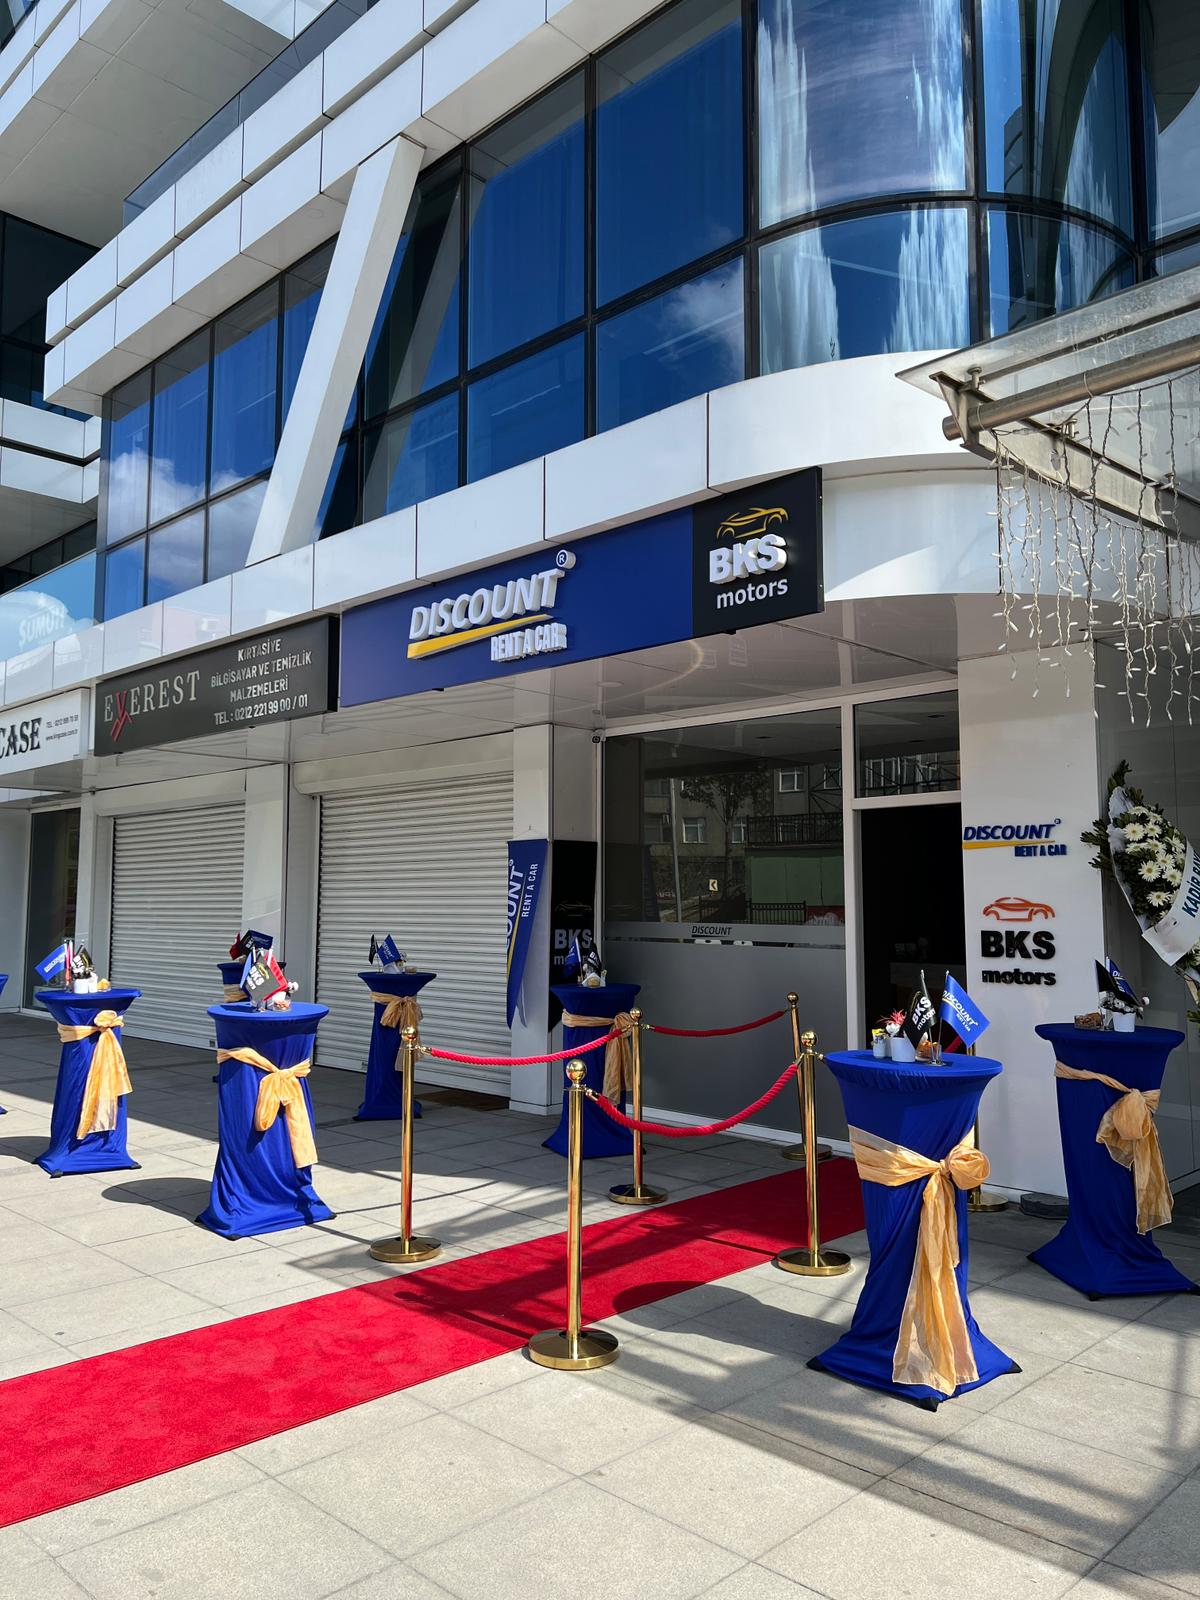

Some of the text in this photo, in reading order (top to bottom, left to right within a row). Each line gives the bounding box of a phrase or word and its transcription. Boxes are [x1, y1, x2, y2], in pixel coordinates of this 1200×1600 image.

[709, 534, 788, 584] BKS
[409, 568, 566, 640] DISCOUNT
[716, 578, 788, 609] motors
[238, 639, 282, 662] KIRTASİYE
[490, 622, 568, 662] RENT A CAR
[211, 650, 312, 688] BİLGİSAYAR VE TEMİZLİK
[103, 670, 200, 724] EVEREST
[230, 675, 288, 702] MALZEMELERİ
[235, 706, 252, 721] 0212
[253, 703, 267, 717] 221
[268, 700, 279, 714] 99
[280, 698, 291, 712] 00
[299, 694, 308, 708] 01
[963, 824, 1056, 840] DISCOUNT
[1014, 844, 1067, 857] RENT A CAR
[521, 893, 533, 918] RENT
[528, 863, 539, 882] CAR
[554, 929, 592, 949] BKS
[692, 925, 733, 936] DISCOUNT
[981, 930, 1056, 960] BKS
[981, 969, 1057, 986] motors
[912, 996, 932, 1025] BKS
